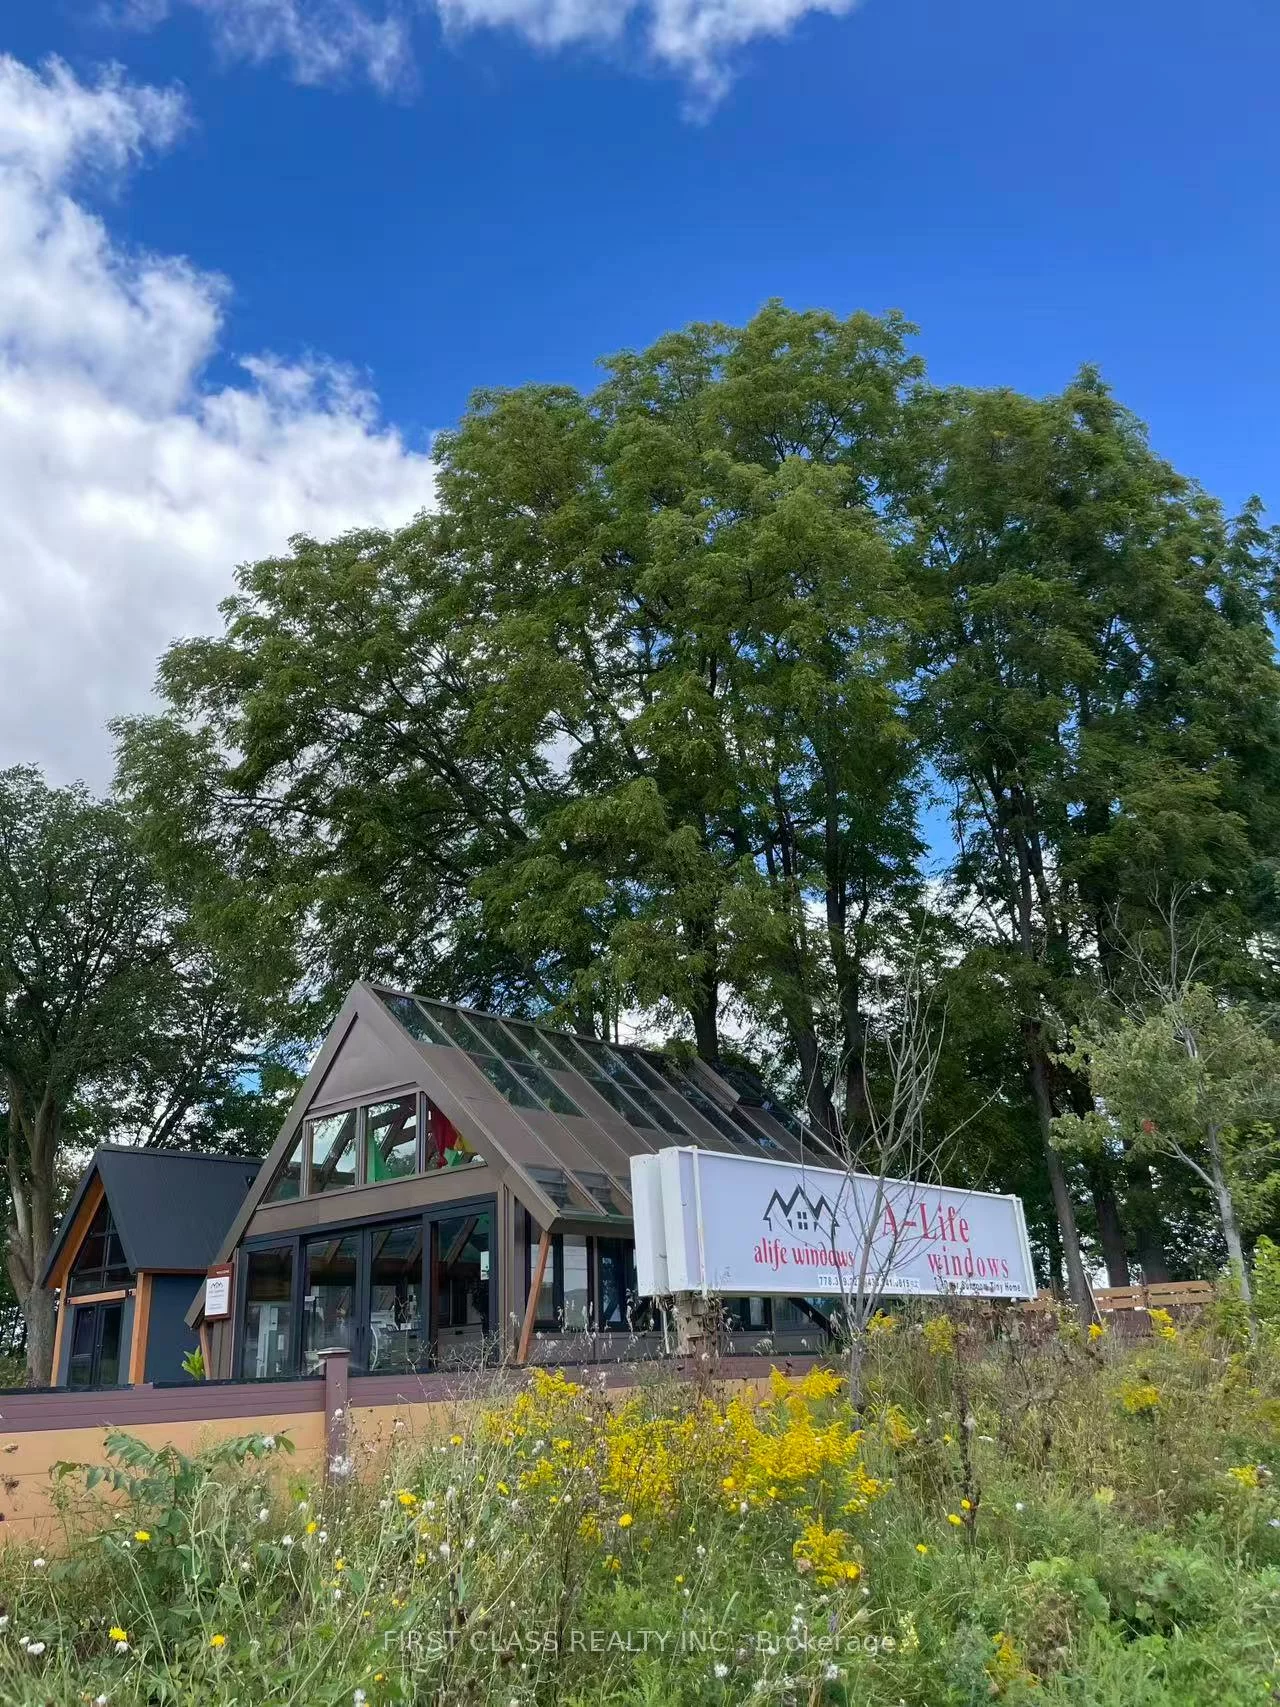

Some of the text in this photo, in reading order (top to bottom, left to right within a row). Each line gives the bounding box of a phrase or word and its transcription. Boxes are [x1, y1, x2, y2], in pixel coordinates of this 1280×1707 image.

[882, 1203, 970, 1242] A-Life
[754, 1236, 856, 1271] alife windows
[926, 1245, 1009, 1278] windows
[1004, 1282, 1021, 1292] Home
